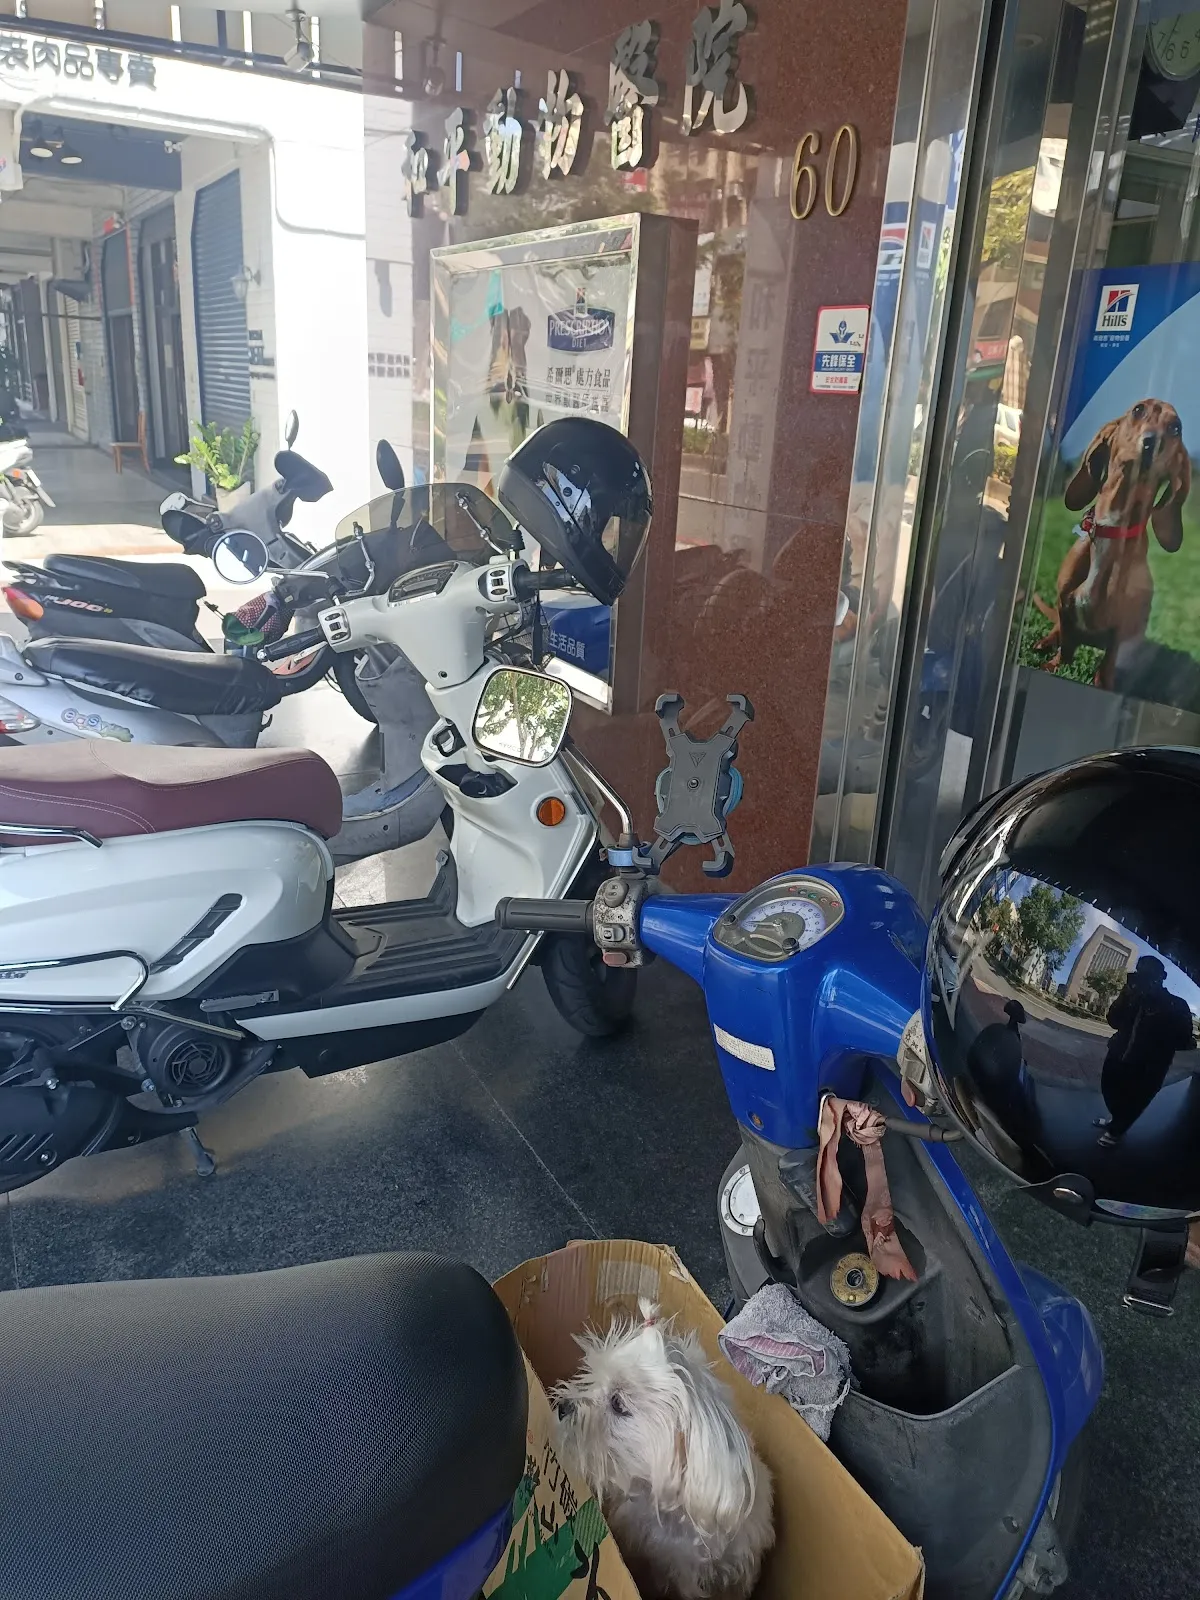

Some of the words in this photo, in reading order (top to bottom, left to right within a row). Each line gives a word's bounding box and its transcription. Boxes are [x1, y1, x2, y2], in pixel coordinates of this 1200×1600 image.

[790, 124, 857, 219] 60
[1102, 314, 1127, 327] Hill's
[571, 338, 587, 348] DIET
[821, 354, 856, 368] 先鋒保全
